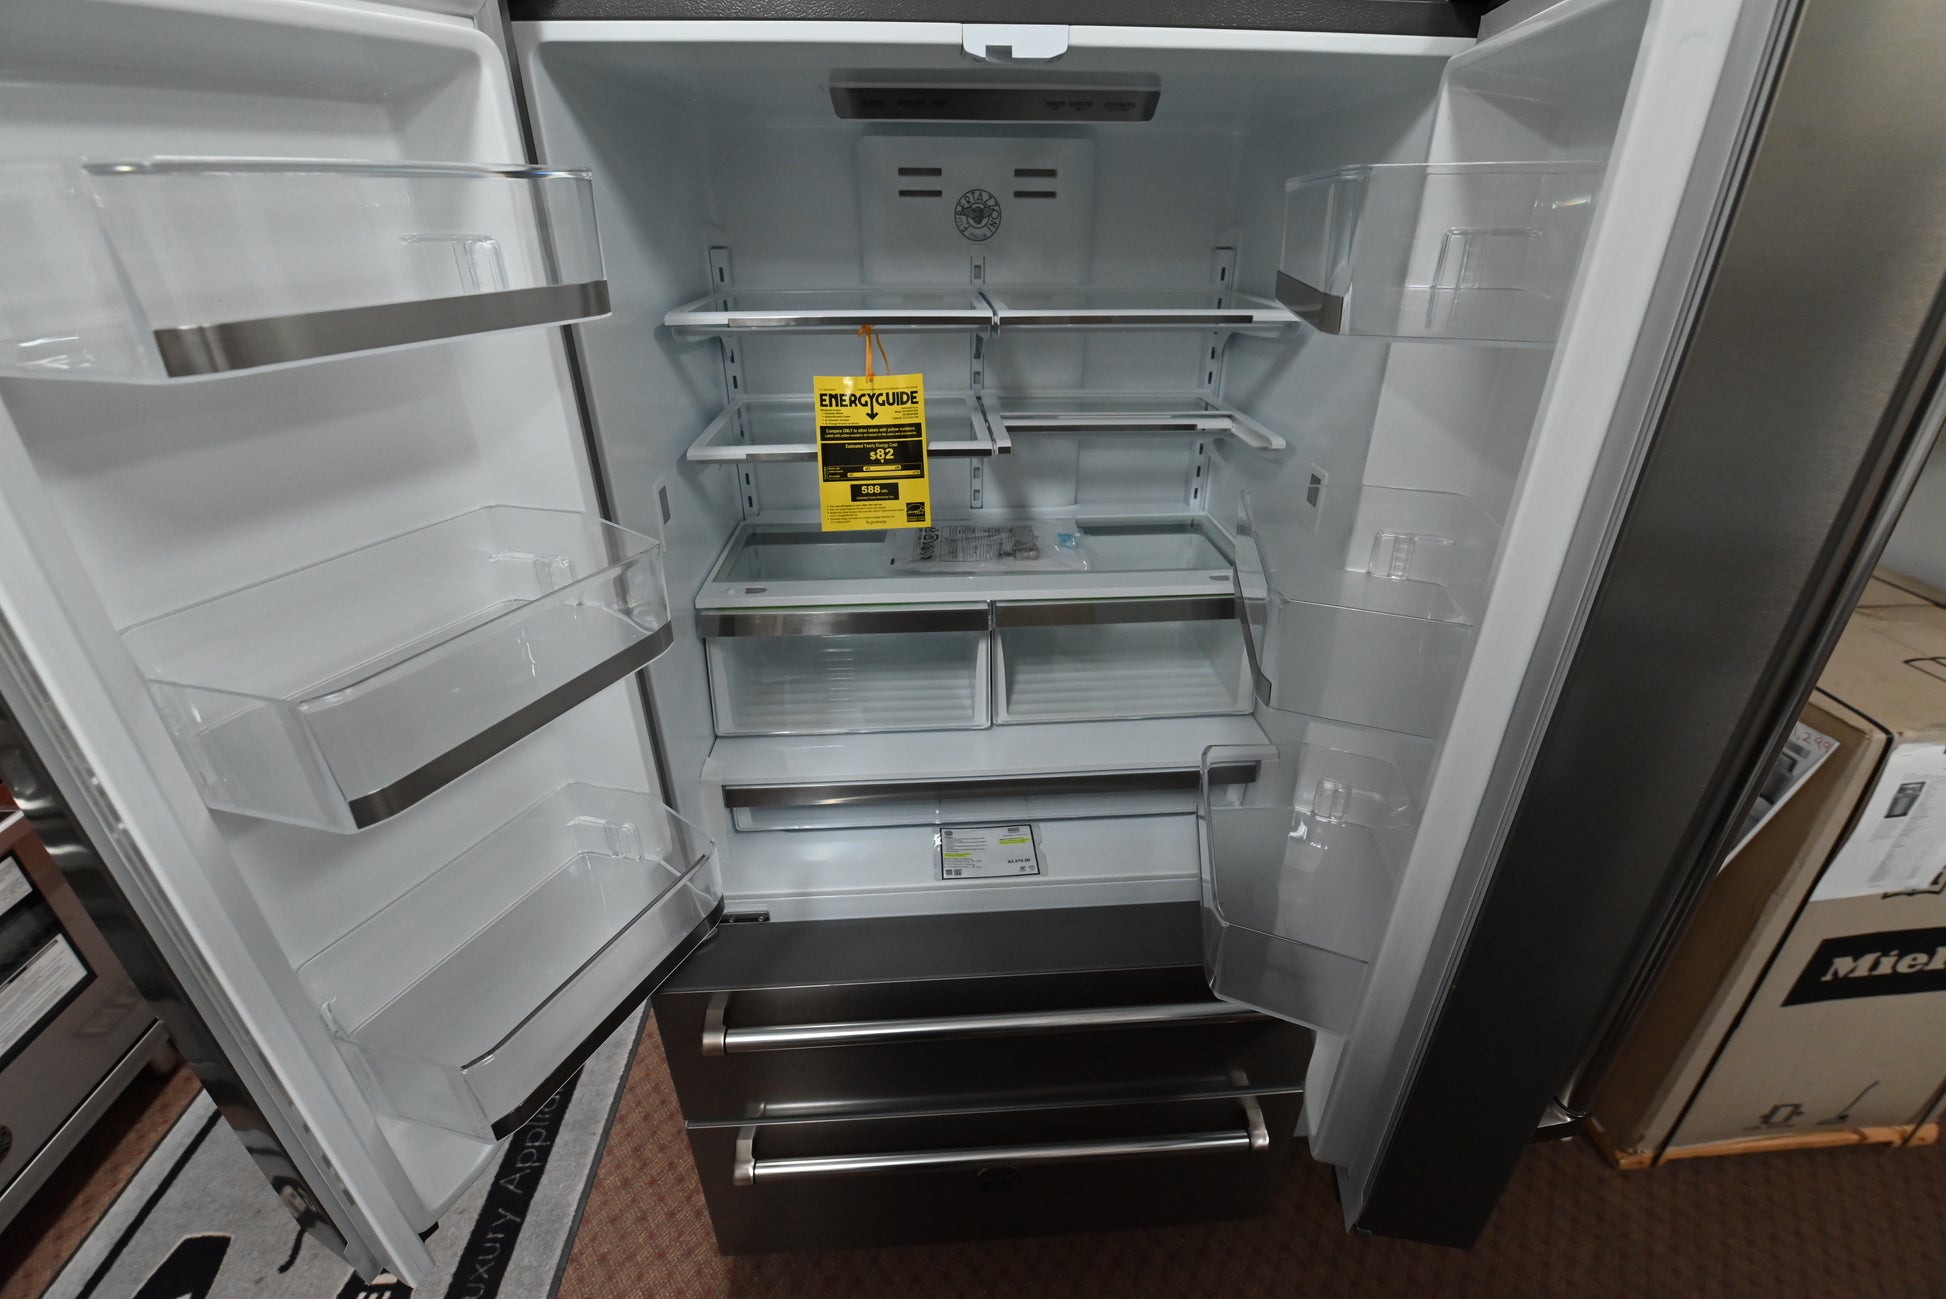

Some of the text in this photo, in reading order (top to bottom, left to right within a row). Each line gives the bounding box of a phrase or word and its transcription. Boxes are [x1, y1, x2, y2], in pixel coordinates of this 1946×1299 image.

[819, 391, 919, 408] ENERGYGUIDE
[870, 448, 894, 460] $82
[861, 485, 880, 494] 588
[1820, 945, 1946, 982] Miel
[464, 1088, 564, 1299] uxury Applia
